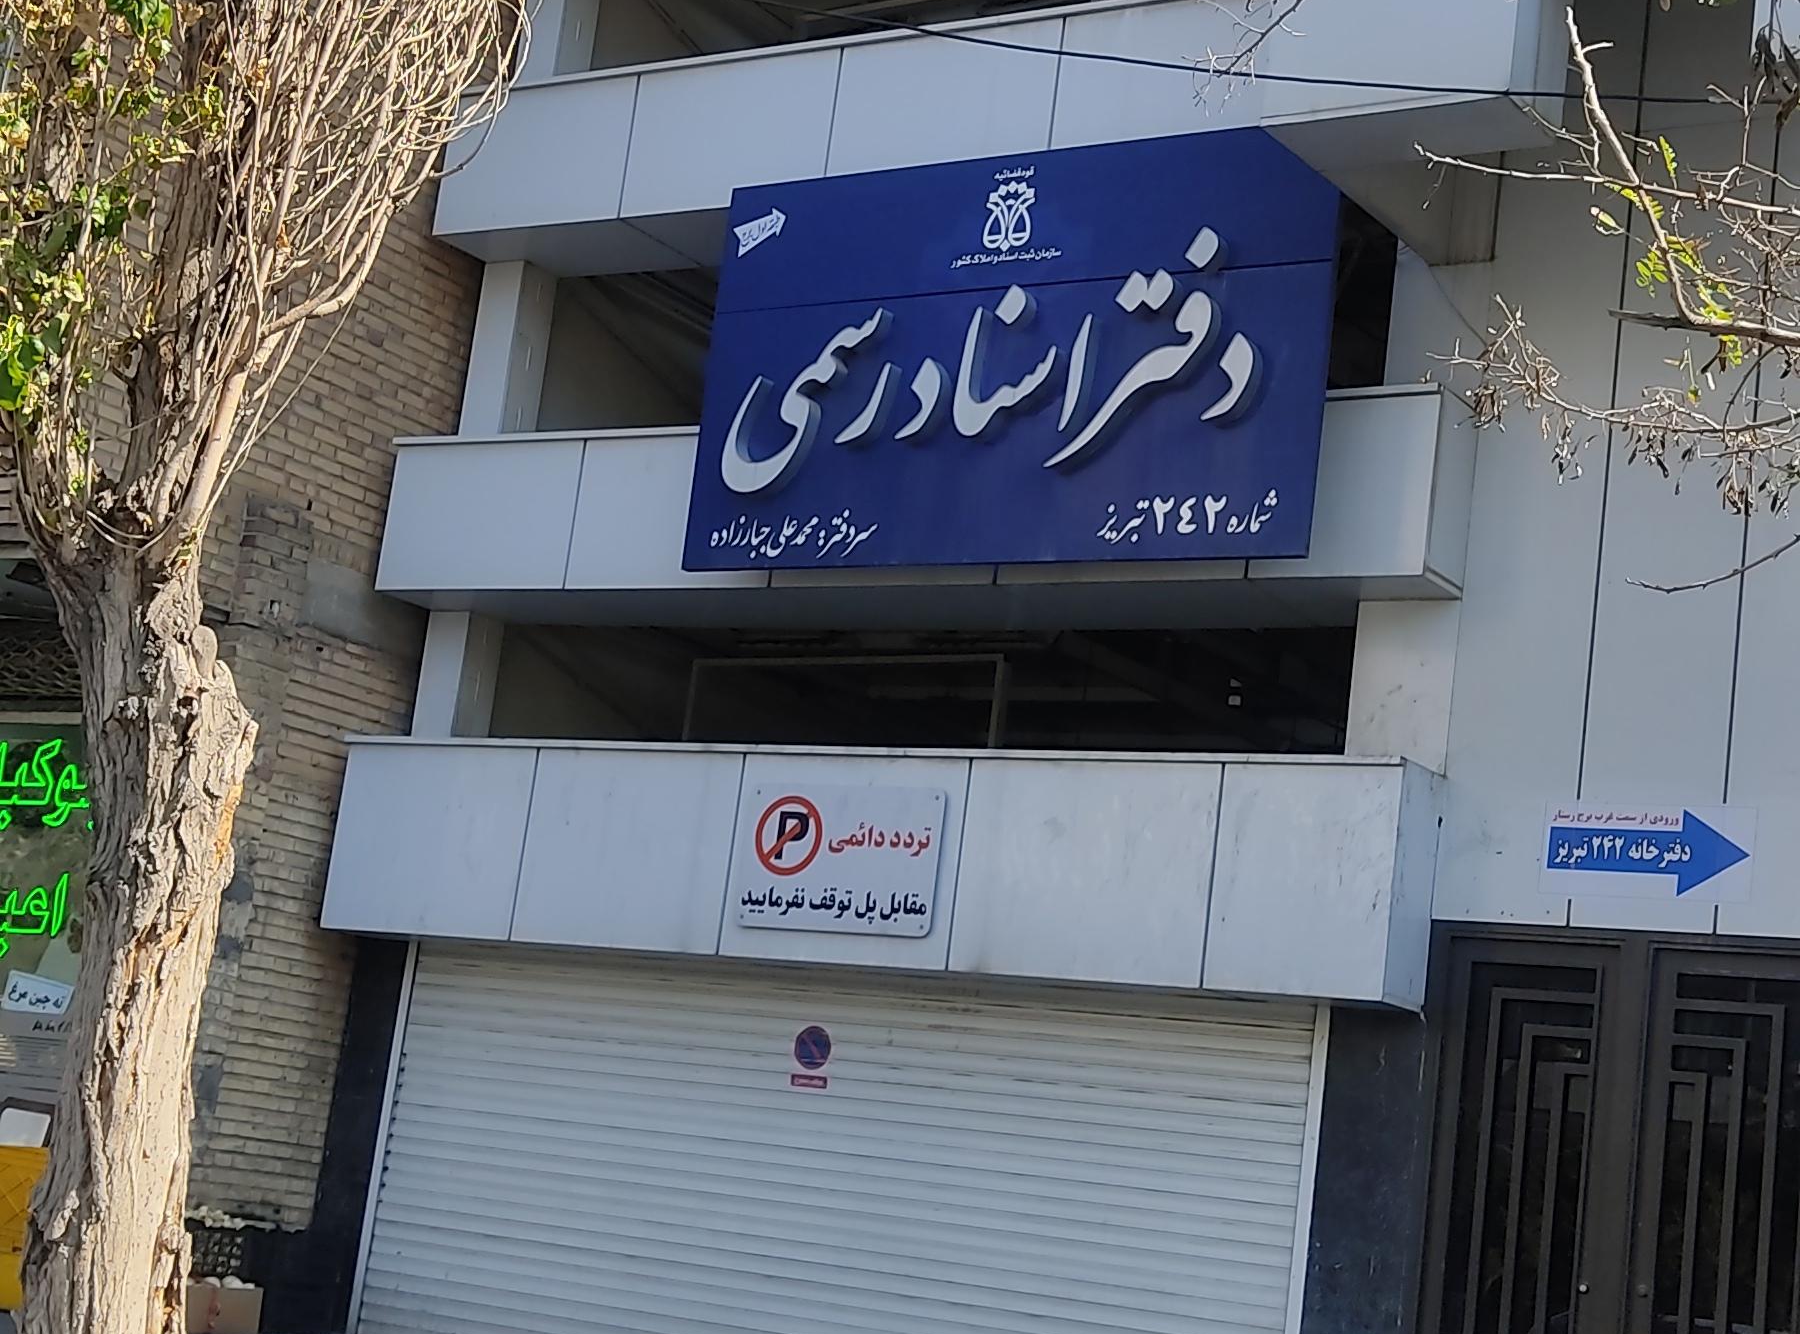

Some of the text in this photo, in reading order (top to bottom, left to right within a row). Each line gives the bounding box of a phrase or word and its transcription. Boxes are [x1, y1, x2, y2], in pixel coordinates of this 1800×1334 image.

[950, 255, 972, 268] کشور
[1018, 249, 1035, 262] ثبت
[1035, 247, 1062, 260] سازمان
[720, 227, 1258, 493] دفتر اسناد رسمی
[1096, 499, 1150, 544] تبریز
[1227, 489, 1278, 534] شماره
[766, 515, 798, 558] علی
[828, 821, 931, 857] تردد دائمی
[1553, 837, 1589, 864] تبریز
[741, 885, 927, 925] مقابل پل توقف نفرمایید
